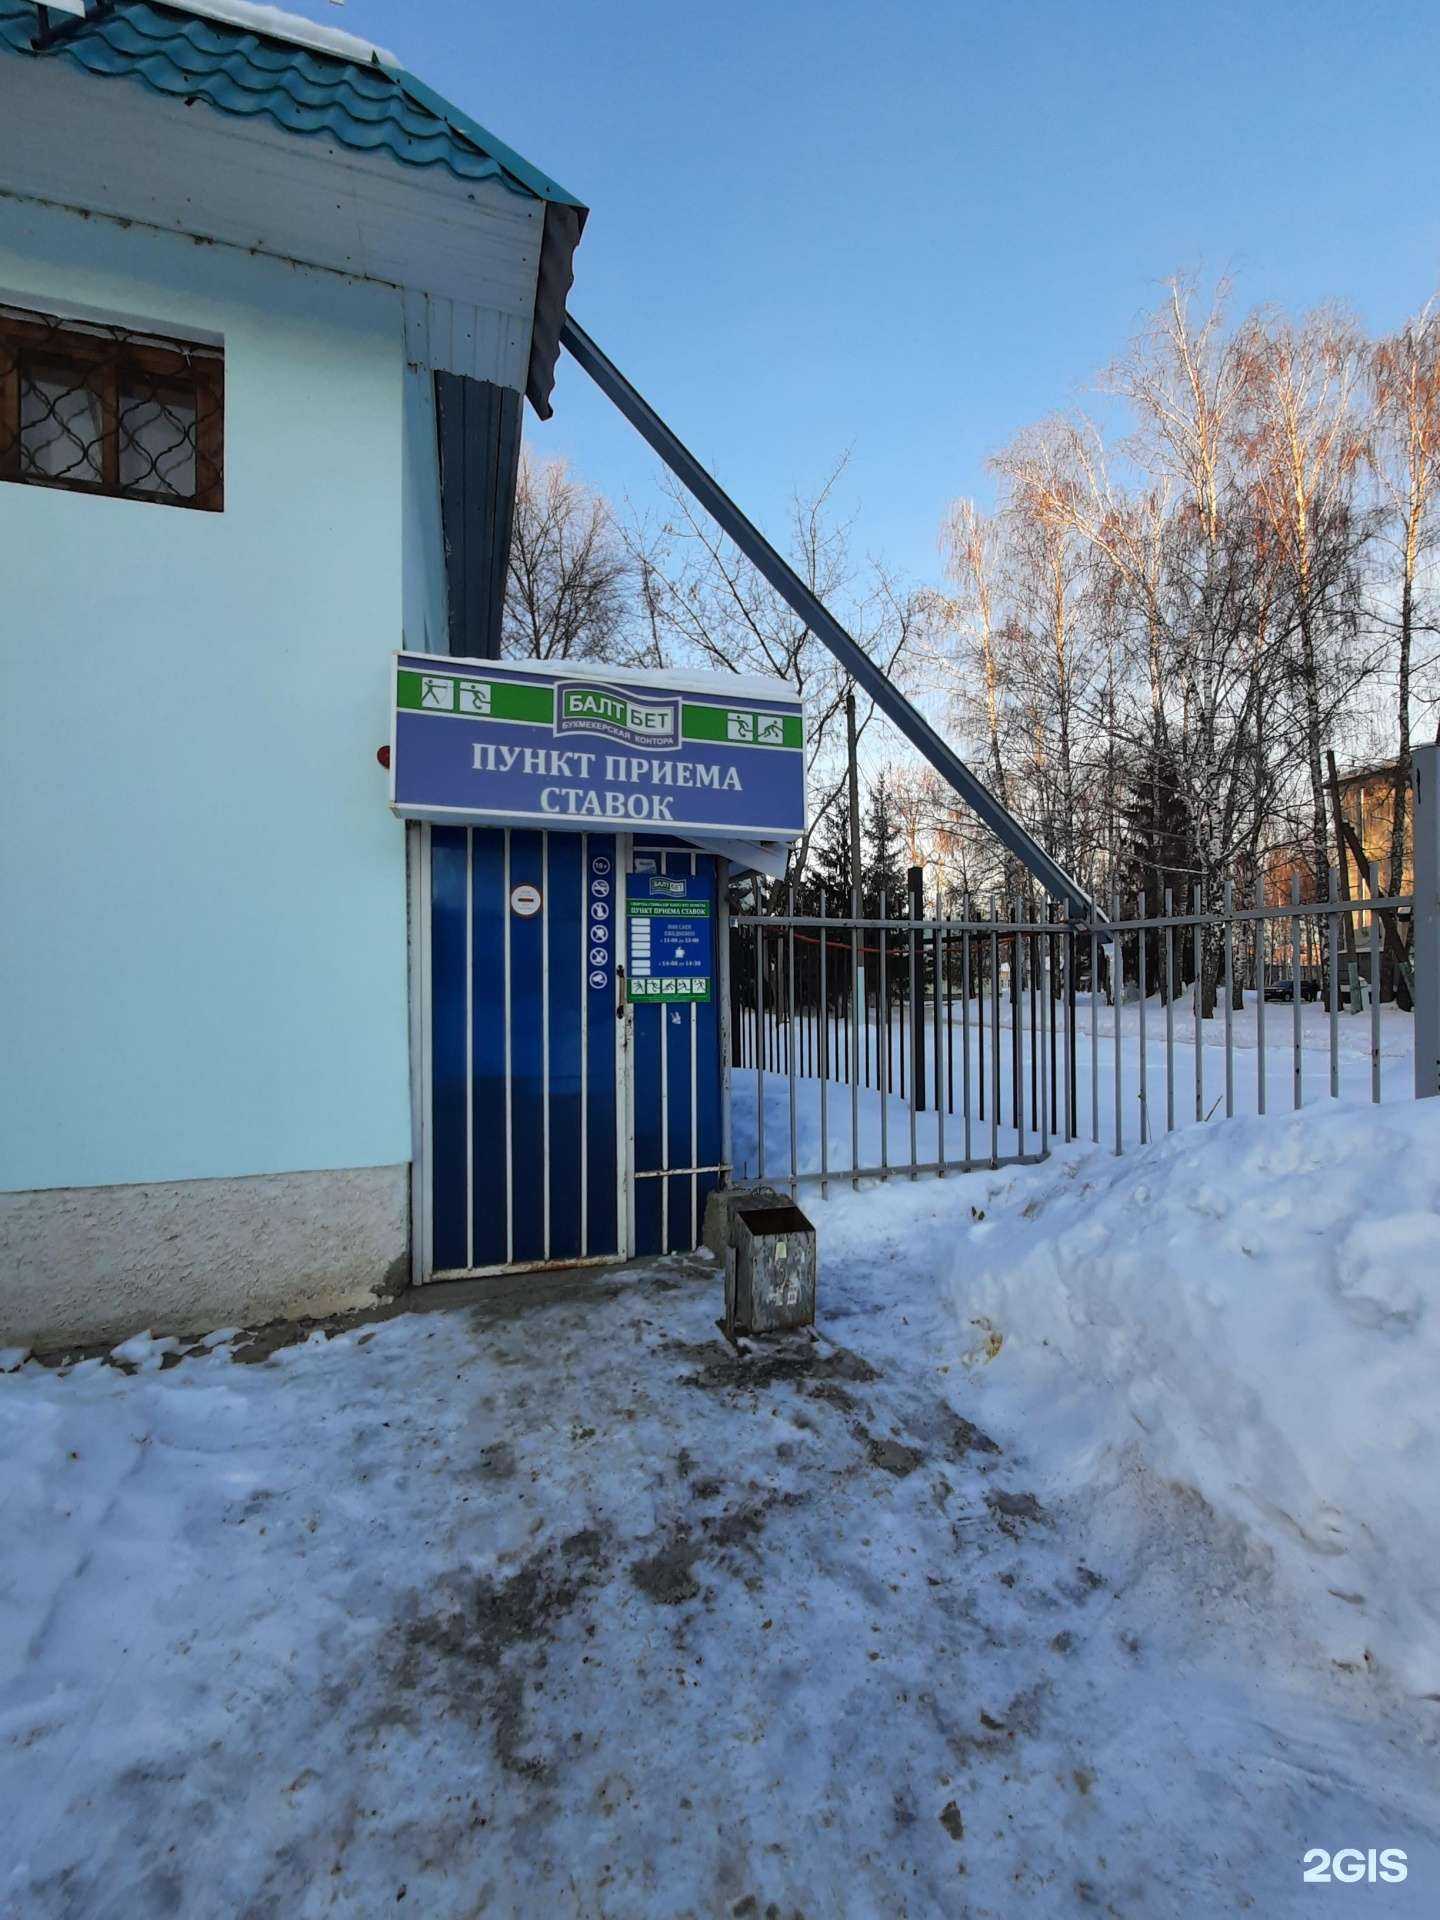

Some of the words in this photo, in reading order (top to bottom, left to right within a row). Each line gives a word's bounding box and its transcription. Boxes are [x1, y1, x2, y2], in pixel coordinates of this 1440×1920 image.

[562, 720, 631, 740] БУКМЕКЕРСКАЯ
[635, 735, 674, 745] КОНТОРА
[472, 743, 596, 779] ПУНКТ
[604, 755, 744, 791] ПРИЕМА
[540, 787, 674, 821] СТАВОК
[630, 906, 652, 914] ПУНКТ
[681, 907, 706, 915] СТАВОК
